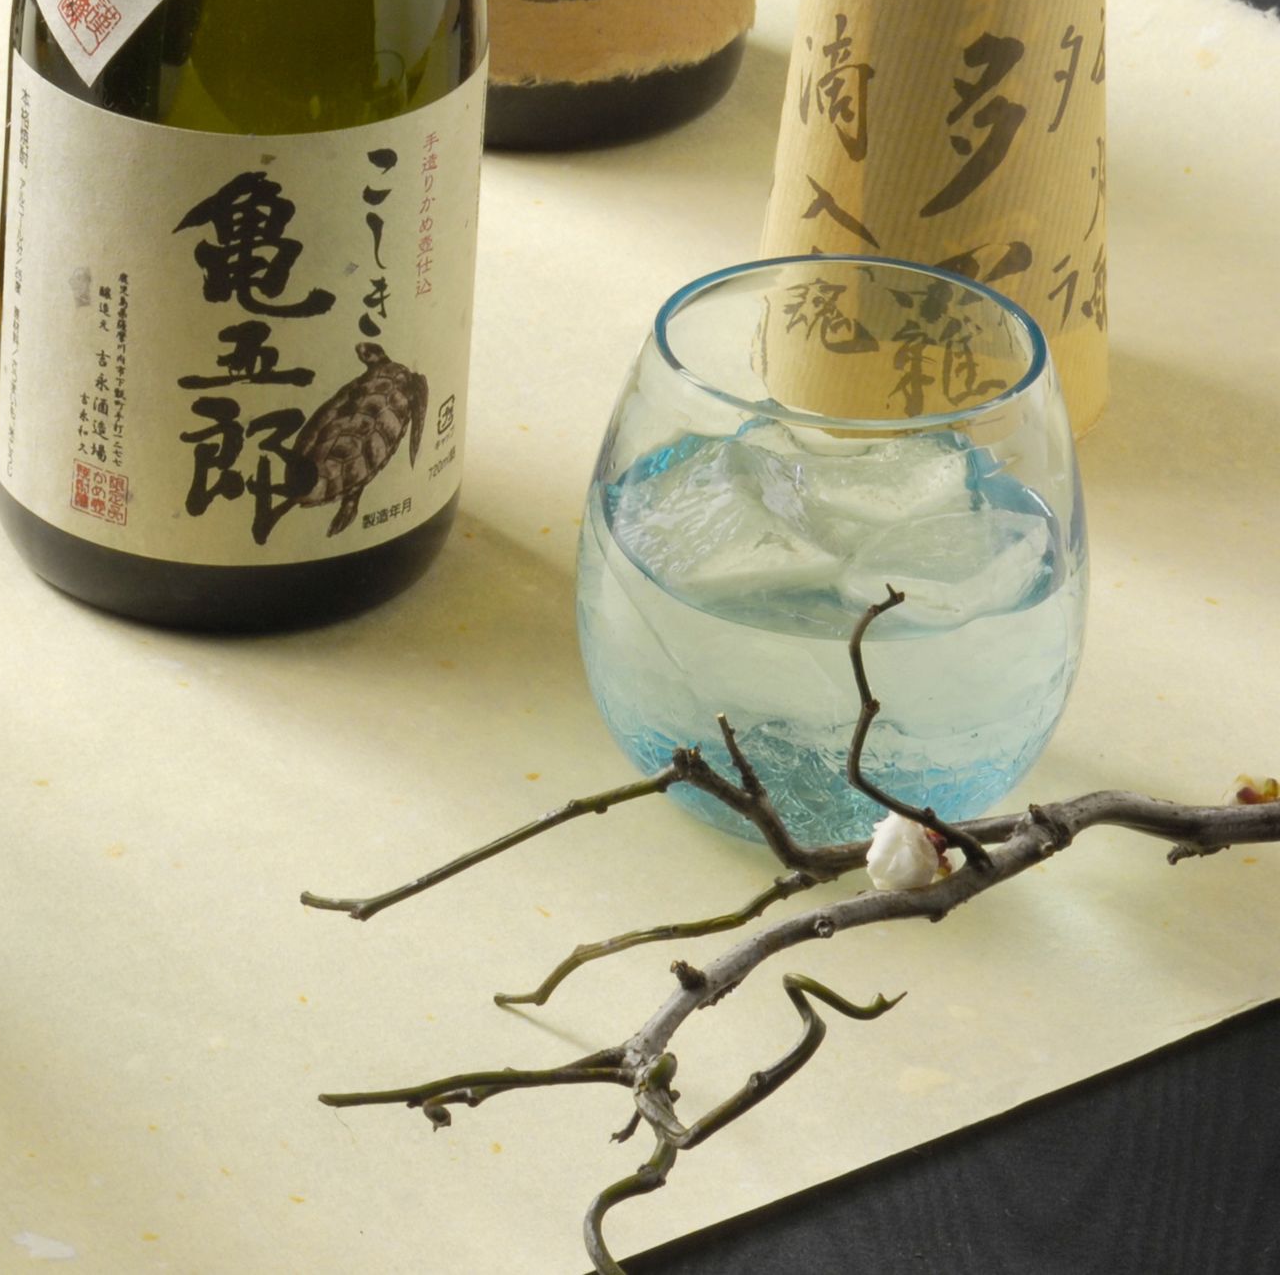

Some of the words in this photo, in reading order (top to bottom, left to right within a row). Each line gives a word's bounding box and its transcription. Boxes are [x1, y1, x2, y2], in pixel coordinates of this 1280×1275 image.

[361, 147, 399, 337] こしき
[414, 130, 440, 299] 手造りかめ壺仕込
[98, 285, 112, 333] 醸造元
[172, 171, 337, 546] 亀五郎
[90, 348, 112, 464] 吉永酒造場
[362, 497, 412, 529] 製造年月
